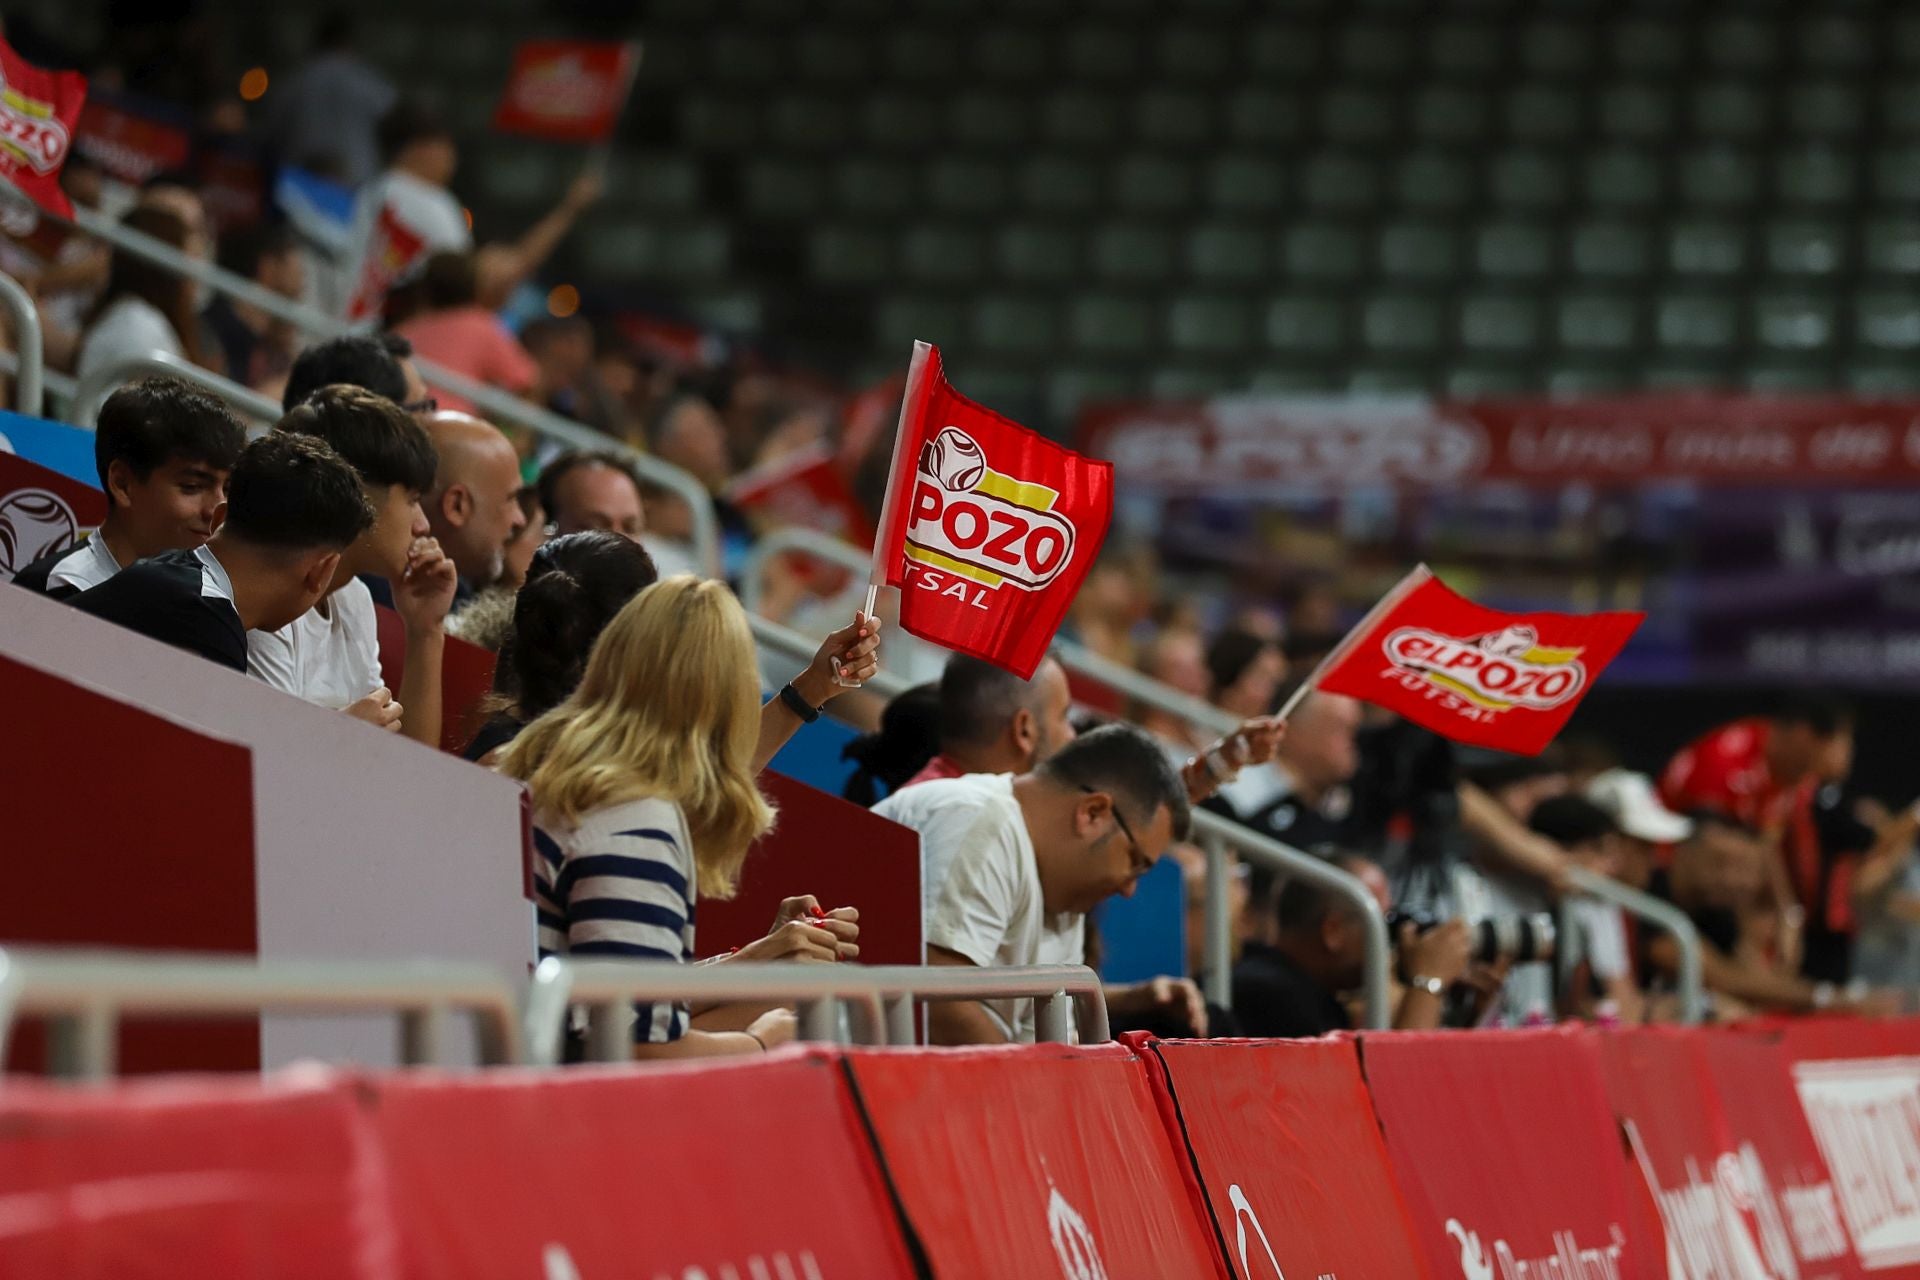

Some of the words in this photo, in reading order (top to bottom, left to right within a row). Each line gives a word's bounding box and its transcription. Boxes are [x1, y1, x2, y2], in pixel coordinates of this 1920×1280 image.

[909, 480, 1066, 576] POZO
[902, 558, 989, 611] TSAL
[1379, 666, 1497, 724] FUTSAL
